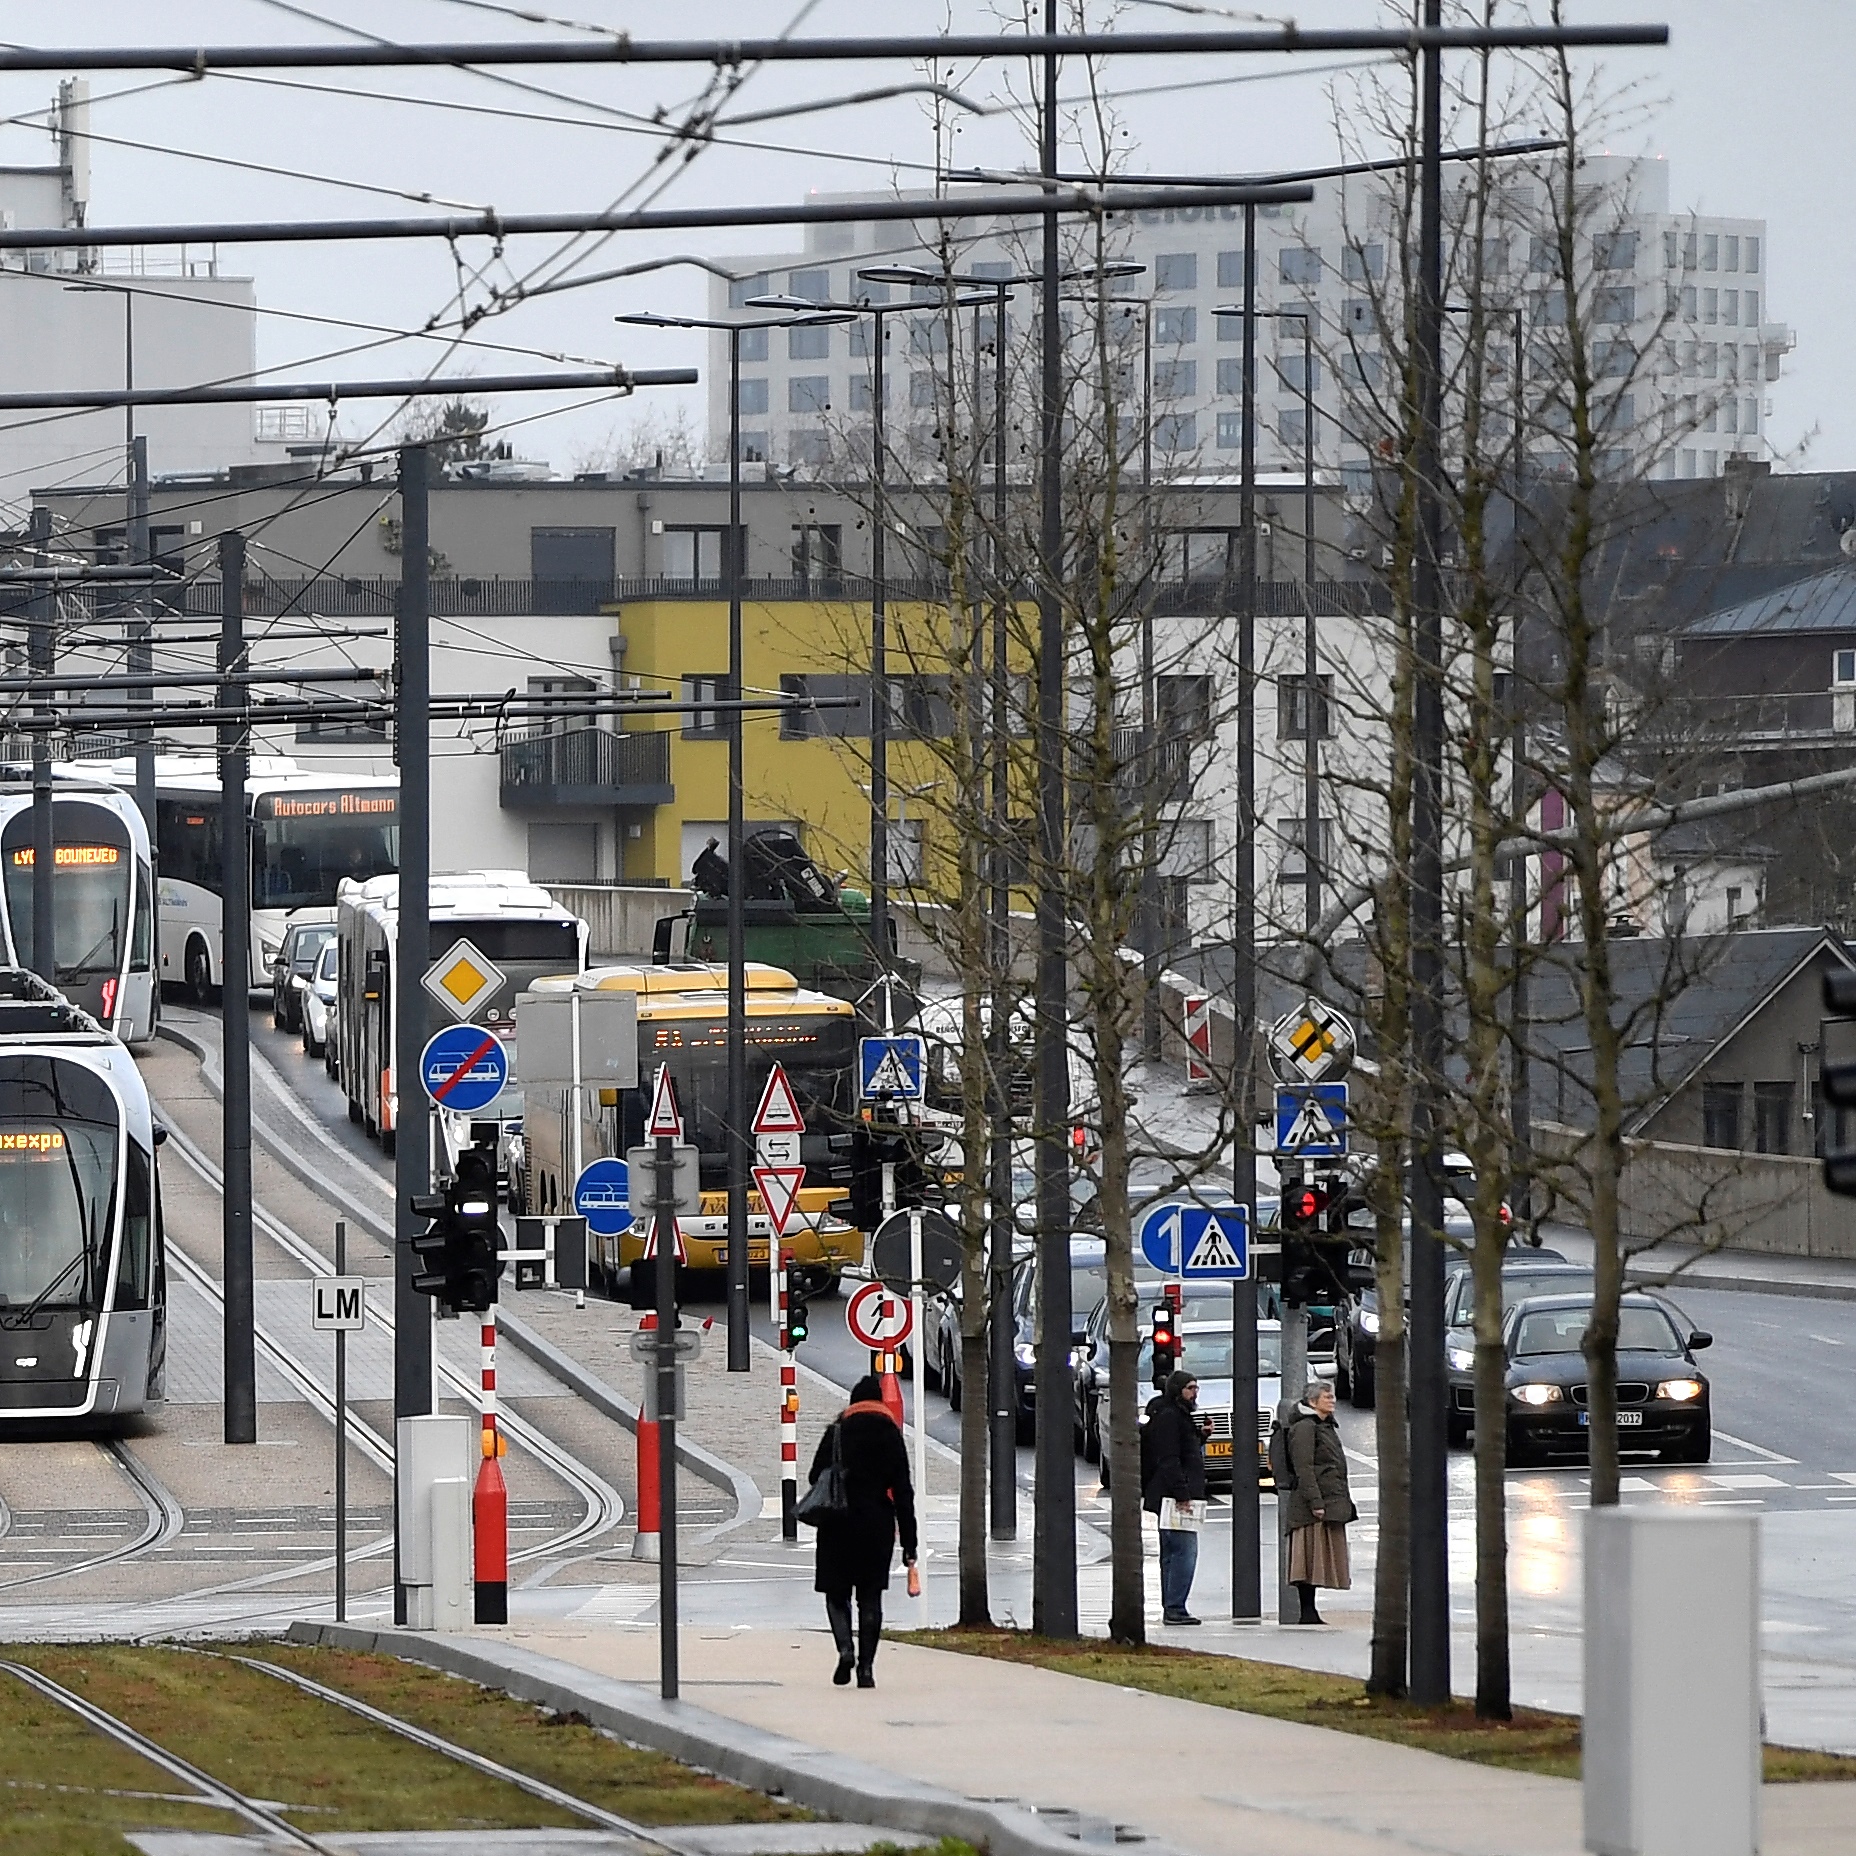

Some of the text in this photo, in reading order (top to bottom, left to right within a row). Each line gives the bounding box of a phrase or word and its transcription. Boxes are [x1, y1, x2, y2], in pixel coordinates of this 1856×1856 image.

[274, 794, 395, 817] Autocars Altmann
[317, 1288, 360, 1319] LM
[1617, 1413, 1640, 1424] 2012
